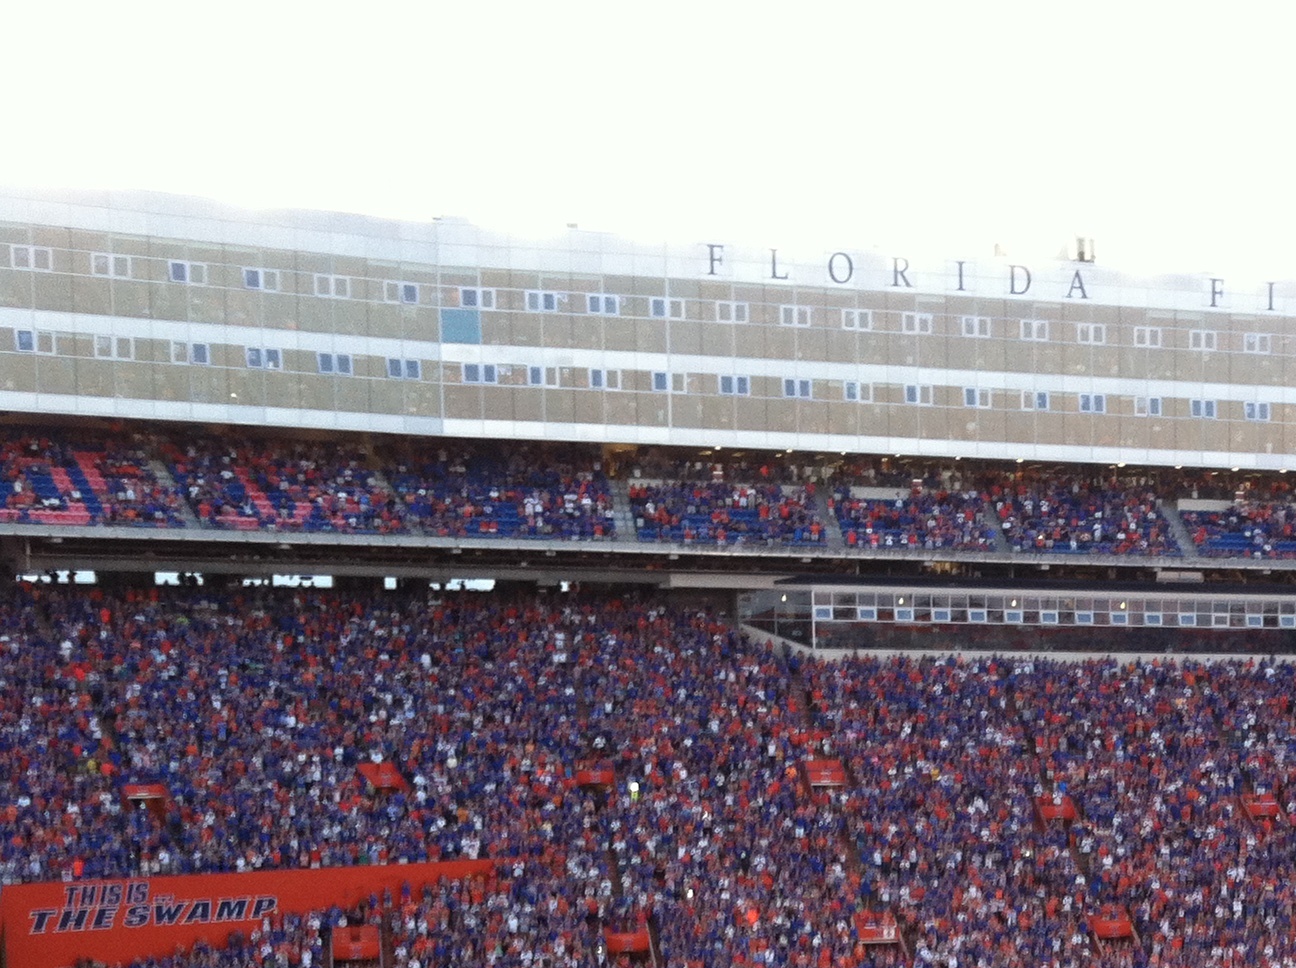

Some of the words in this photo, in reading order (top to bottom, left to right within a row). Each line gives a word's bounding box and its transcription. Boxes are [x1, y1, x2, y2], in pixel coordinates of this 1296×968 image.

[705, 243, 1089, 300] FLORIDA
[64, 881, 123, 908] THIS
[125, 880, 150, 906] IS
[28, 906, 119, 936] THE
[122, 895, 278, 928] SWAMP
